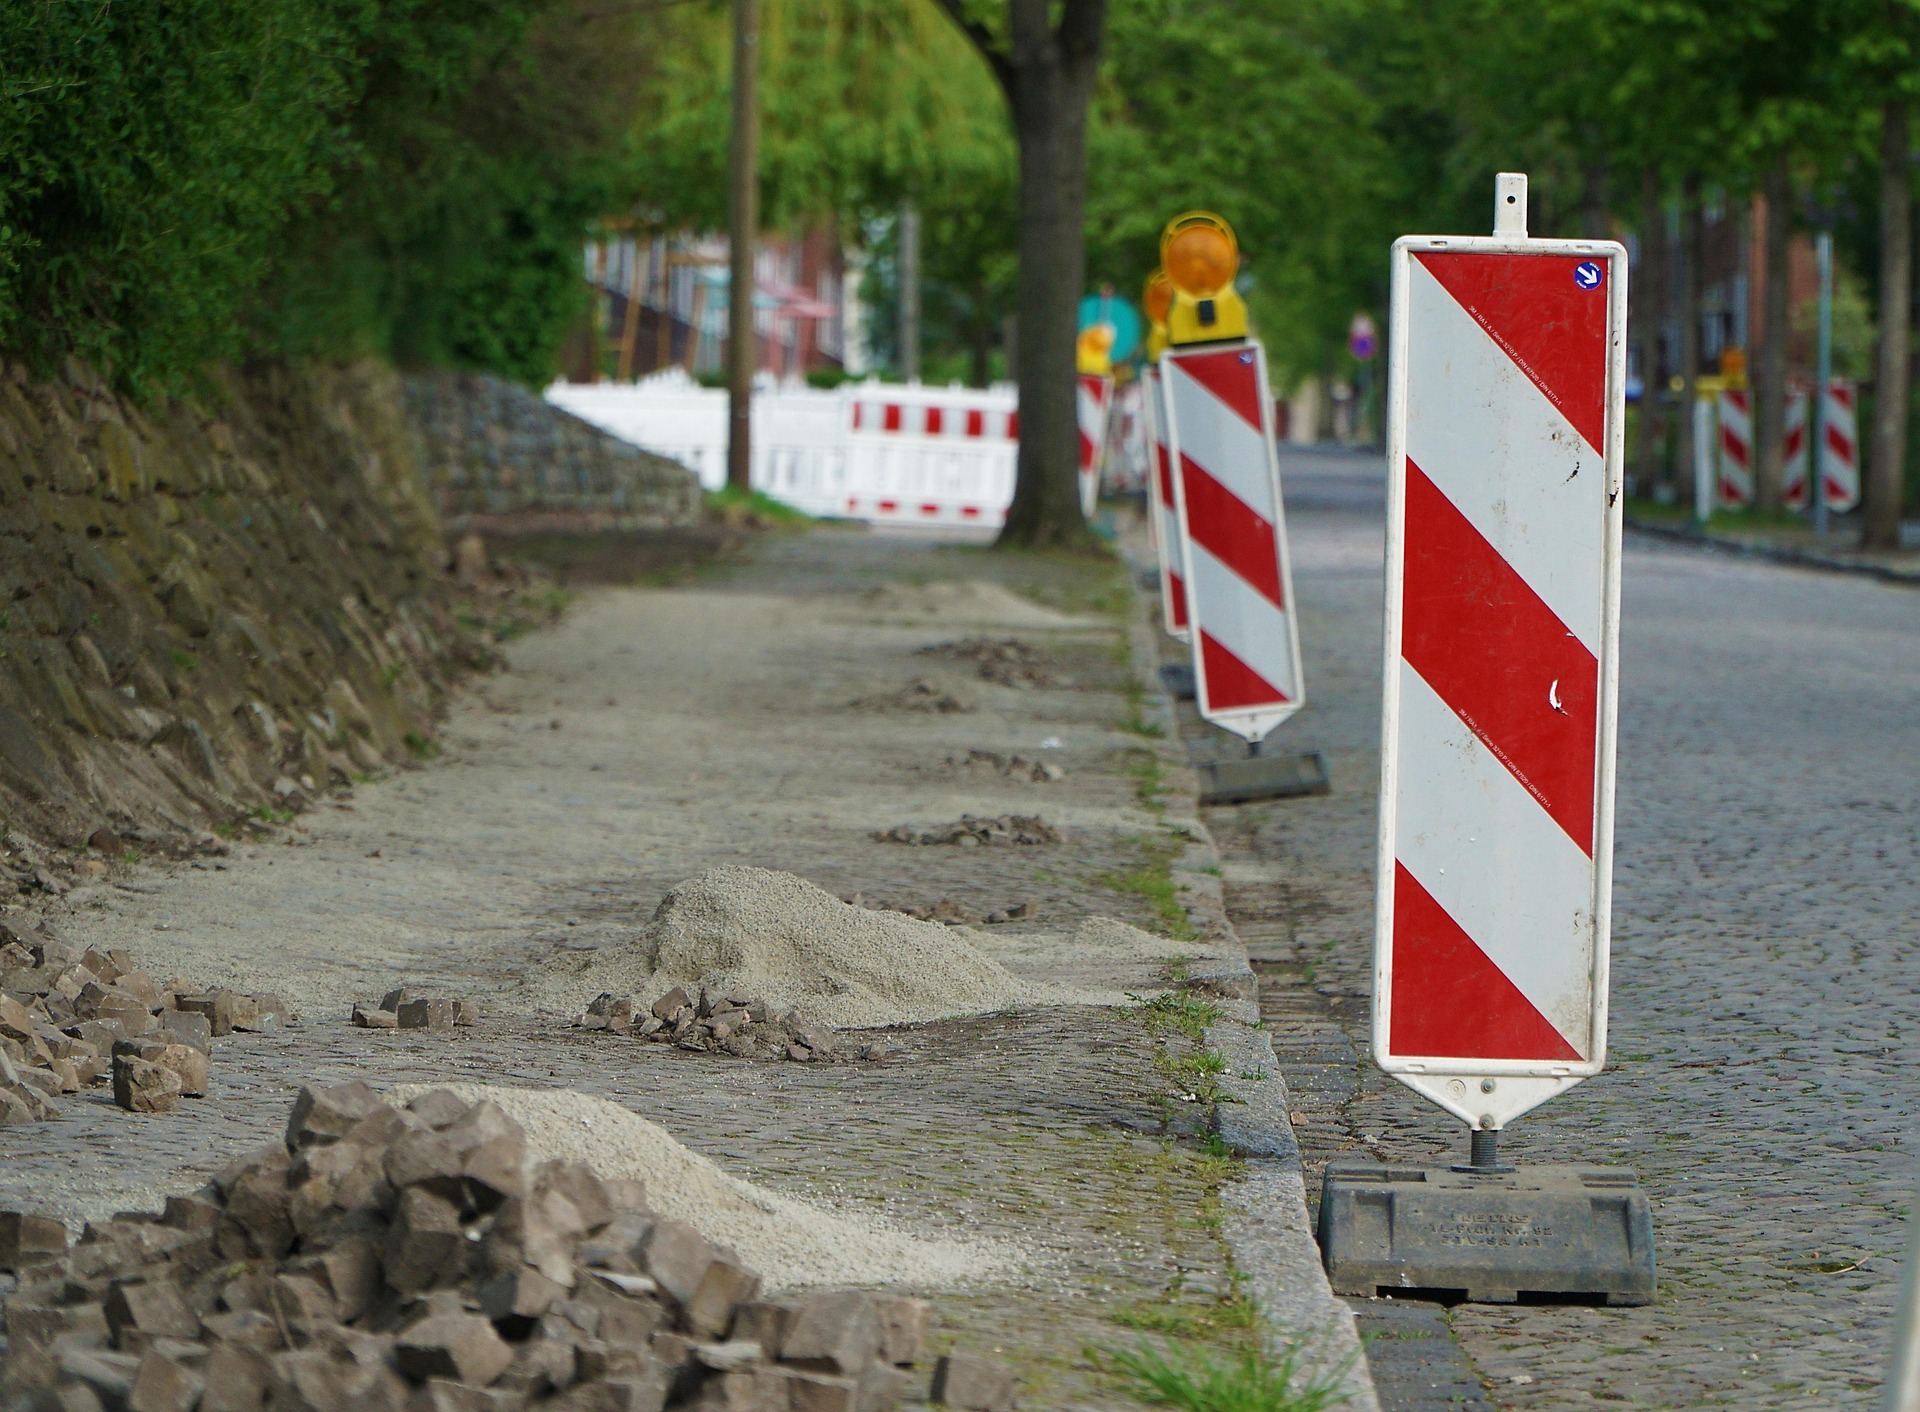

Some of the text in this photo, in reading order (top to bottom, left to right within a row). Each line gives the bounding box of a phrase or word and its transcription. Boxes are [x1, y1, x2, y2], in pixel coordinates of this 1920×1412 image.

[1469, 305, 1477, 314] 3M
[1503, 342, 1514, 353] 3210
[1518, 359, 1528, 367] DIN
[1526, 367, 1539, 380] 67520
[1540, 382, 1549, 390] DIN
[1547, 390, 1562, 405] 6171-1
[1459, 708, 1467, 717] 3M
[1493, 746, 1504, 756] 3210
[1508, 762, 1517, 770] DIN
[1515, 770, 1529, 783] 67520
[1529, 785, 1539, 793] DIN
[1537, 793, 1551, 807] 6171-1
